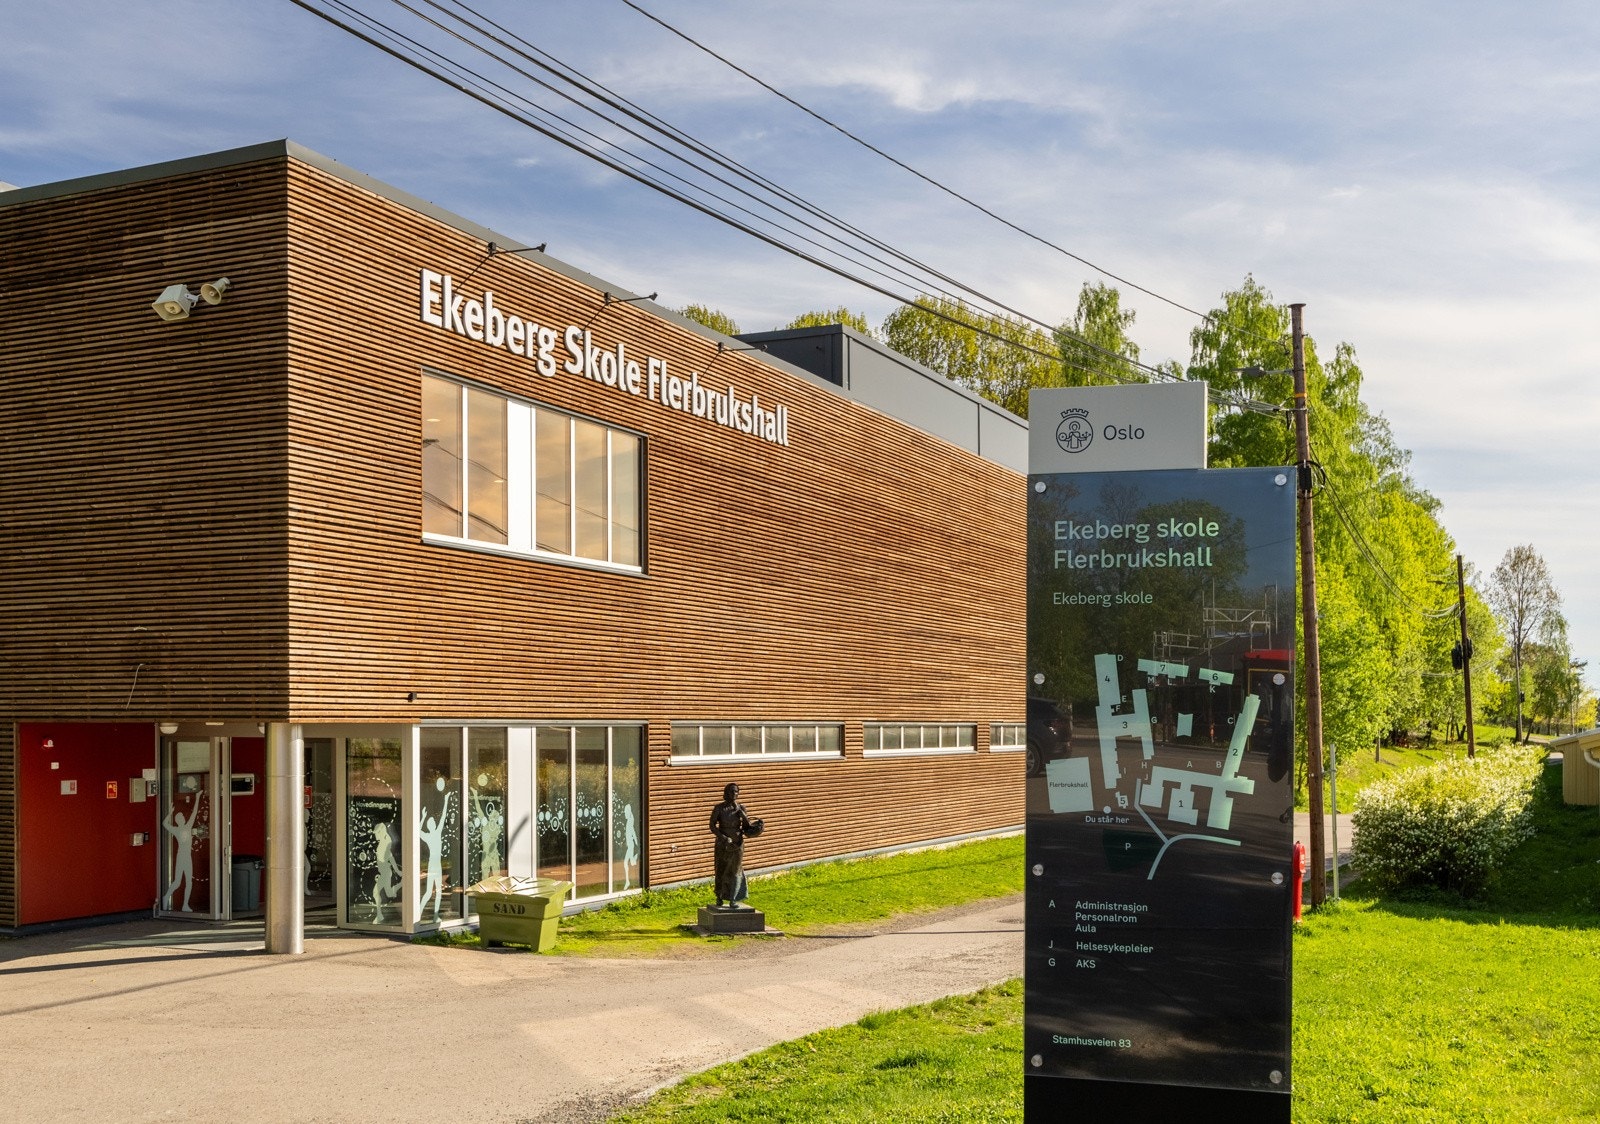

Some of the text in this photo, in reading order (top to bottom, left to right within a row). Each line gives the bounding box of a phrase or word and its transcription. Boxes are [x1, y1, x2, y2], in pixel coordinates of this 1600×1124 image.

[420, 268, 790, 447] Ekeberg Skole Flerbrukshall
[1103, 424, 1145, 440] Oslo
[1054, 518, 1220, 543] Ekeberg skole
[1054, 547, 1213, 569] Flerbrukshall
[1053, 591, 1153, 607] Ekeberg skole
[1117, 654, 1124, 662] D
[1160, 664, 1166, 672] 7
[1104, 675, 1110, 683] 4
[1147, 676, 1155, 684] M
[1212, 673, 1219, 681] 6
[1209, 685, 1216, 693] K
[1121, 695, 1127, 703] E
[1115, 704, 1121, 712] F
[1151, 716, 1158, 724] G
[1227, 716, 1234, 725] C
[1122, 721, 1128, 729] 3
[1232, 748, 1238, 756] 2
[1049, 781, 1089, 789] Flerbrukshall
[1120, 796, 1126, 805] 5
[1178, 800, 1184, 808] 1
[1085, 815, 1130, 824] Du står her
[1125, 842, 1132, 851] P
[493, 902, 526, 915] SAND
[1048, 899, 1148, 914] A Administrasjon
[1075, 912, 1138, 923] Personalrom
[1075, 923, 1097, 933] Aula
[1048, 940, 1154, 954] J Helsesykepleier
[1048, 957, 1097, 969] G AKS
[1052, 1034, 1132, 1048] Stamhusveien 83
